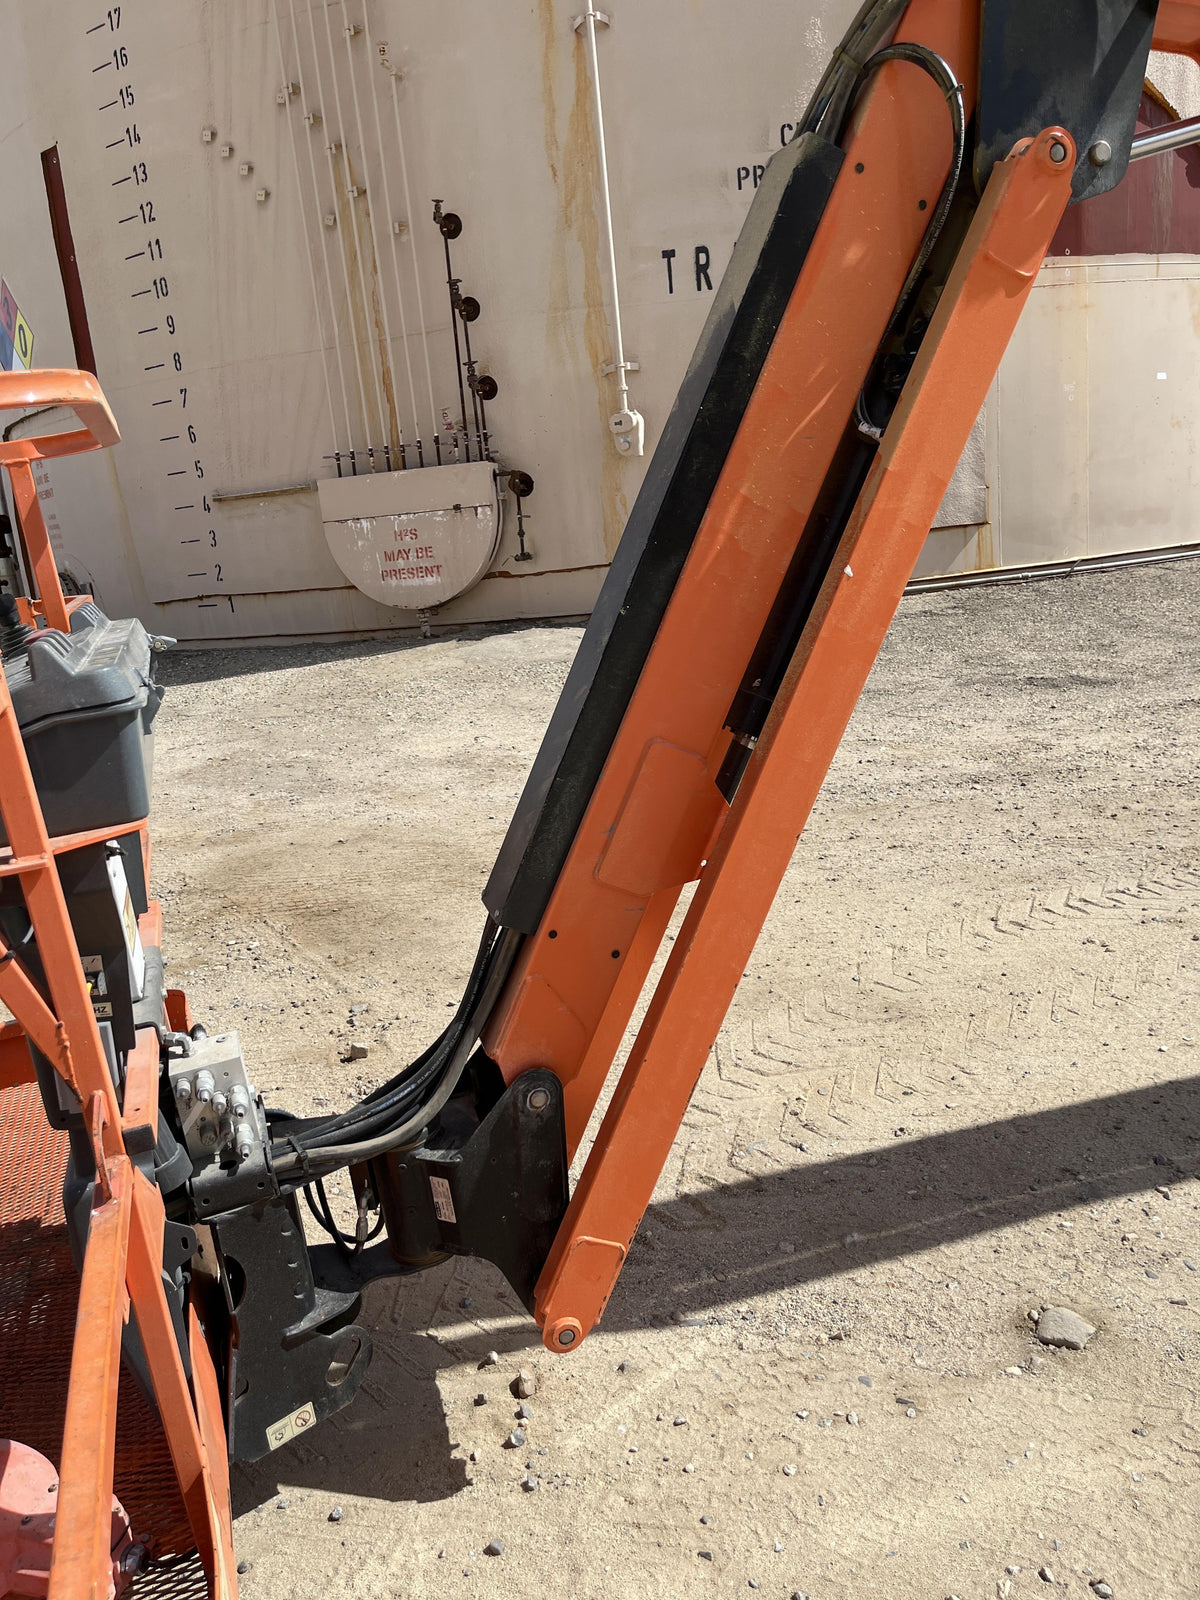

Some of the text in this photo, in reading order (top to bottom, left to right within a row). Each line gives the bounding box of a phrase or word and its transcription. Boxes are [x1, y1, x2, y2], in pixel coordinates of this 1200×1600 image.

[107, 6, 121, 31] 17
[113, 46, 128, 71] 16
[119, 85, 135, 109] 15
[125, 124, 141, 148] 14
[132, 162, 148, 186] 13
[139, 201, 156, 224] 12
[148, 238, 163, 261] 11
[153, 277, 169, 300] 10
[3, 296, 12, 331] 3
[166, 315, 176, 335] 9
[18, 323, 28, 359] 0
[173, 352, 182, 372] 8
[179, 387, 188, 408] 7
[187, 425, 197, 444] 6
[194, 459, 204, 479] 5
[203, 496, 211, 514] 4
[209, 530, 217, 548] 3
[383, 546, 434, 562] MAY BE
[215, 563, 223, 582] 2
[381, 564, 443, 581] PRESENT
[228, 596, 235, 613] 1
